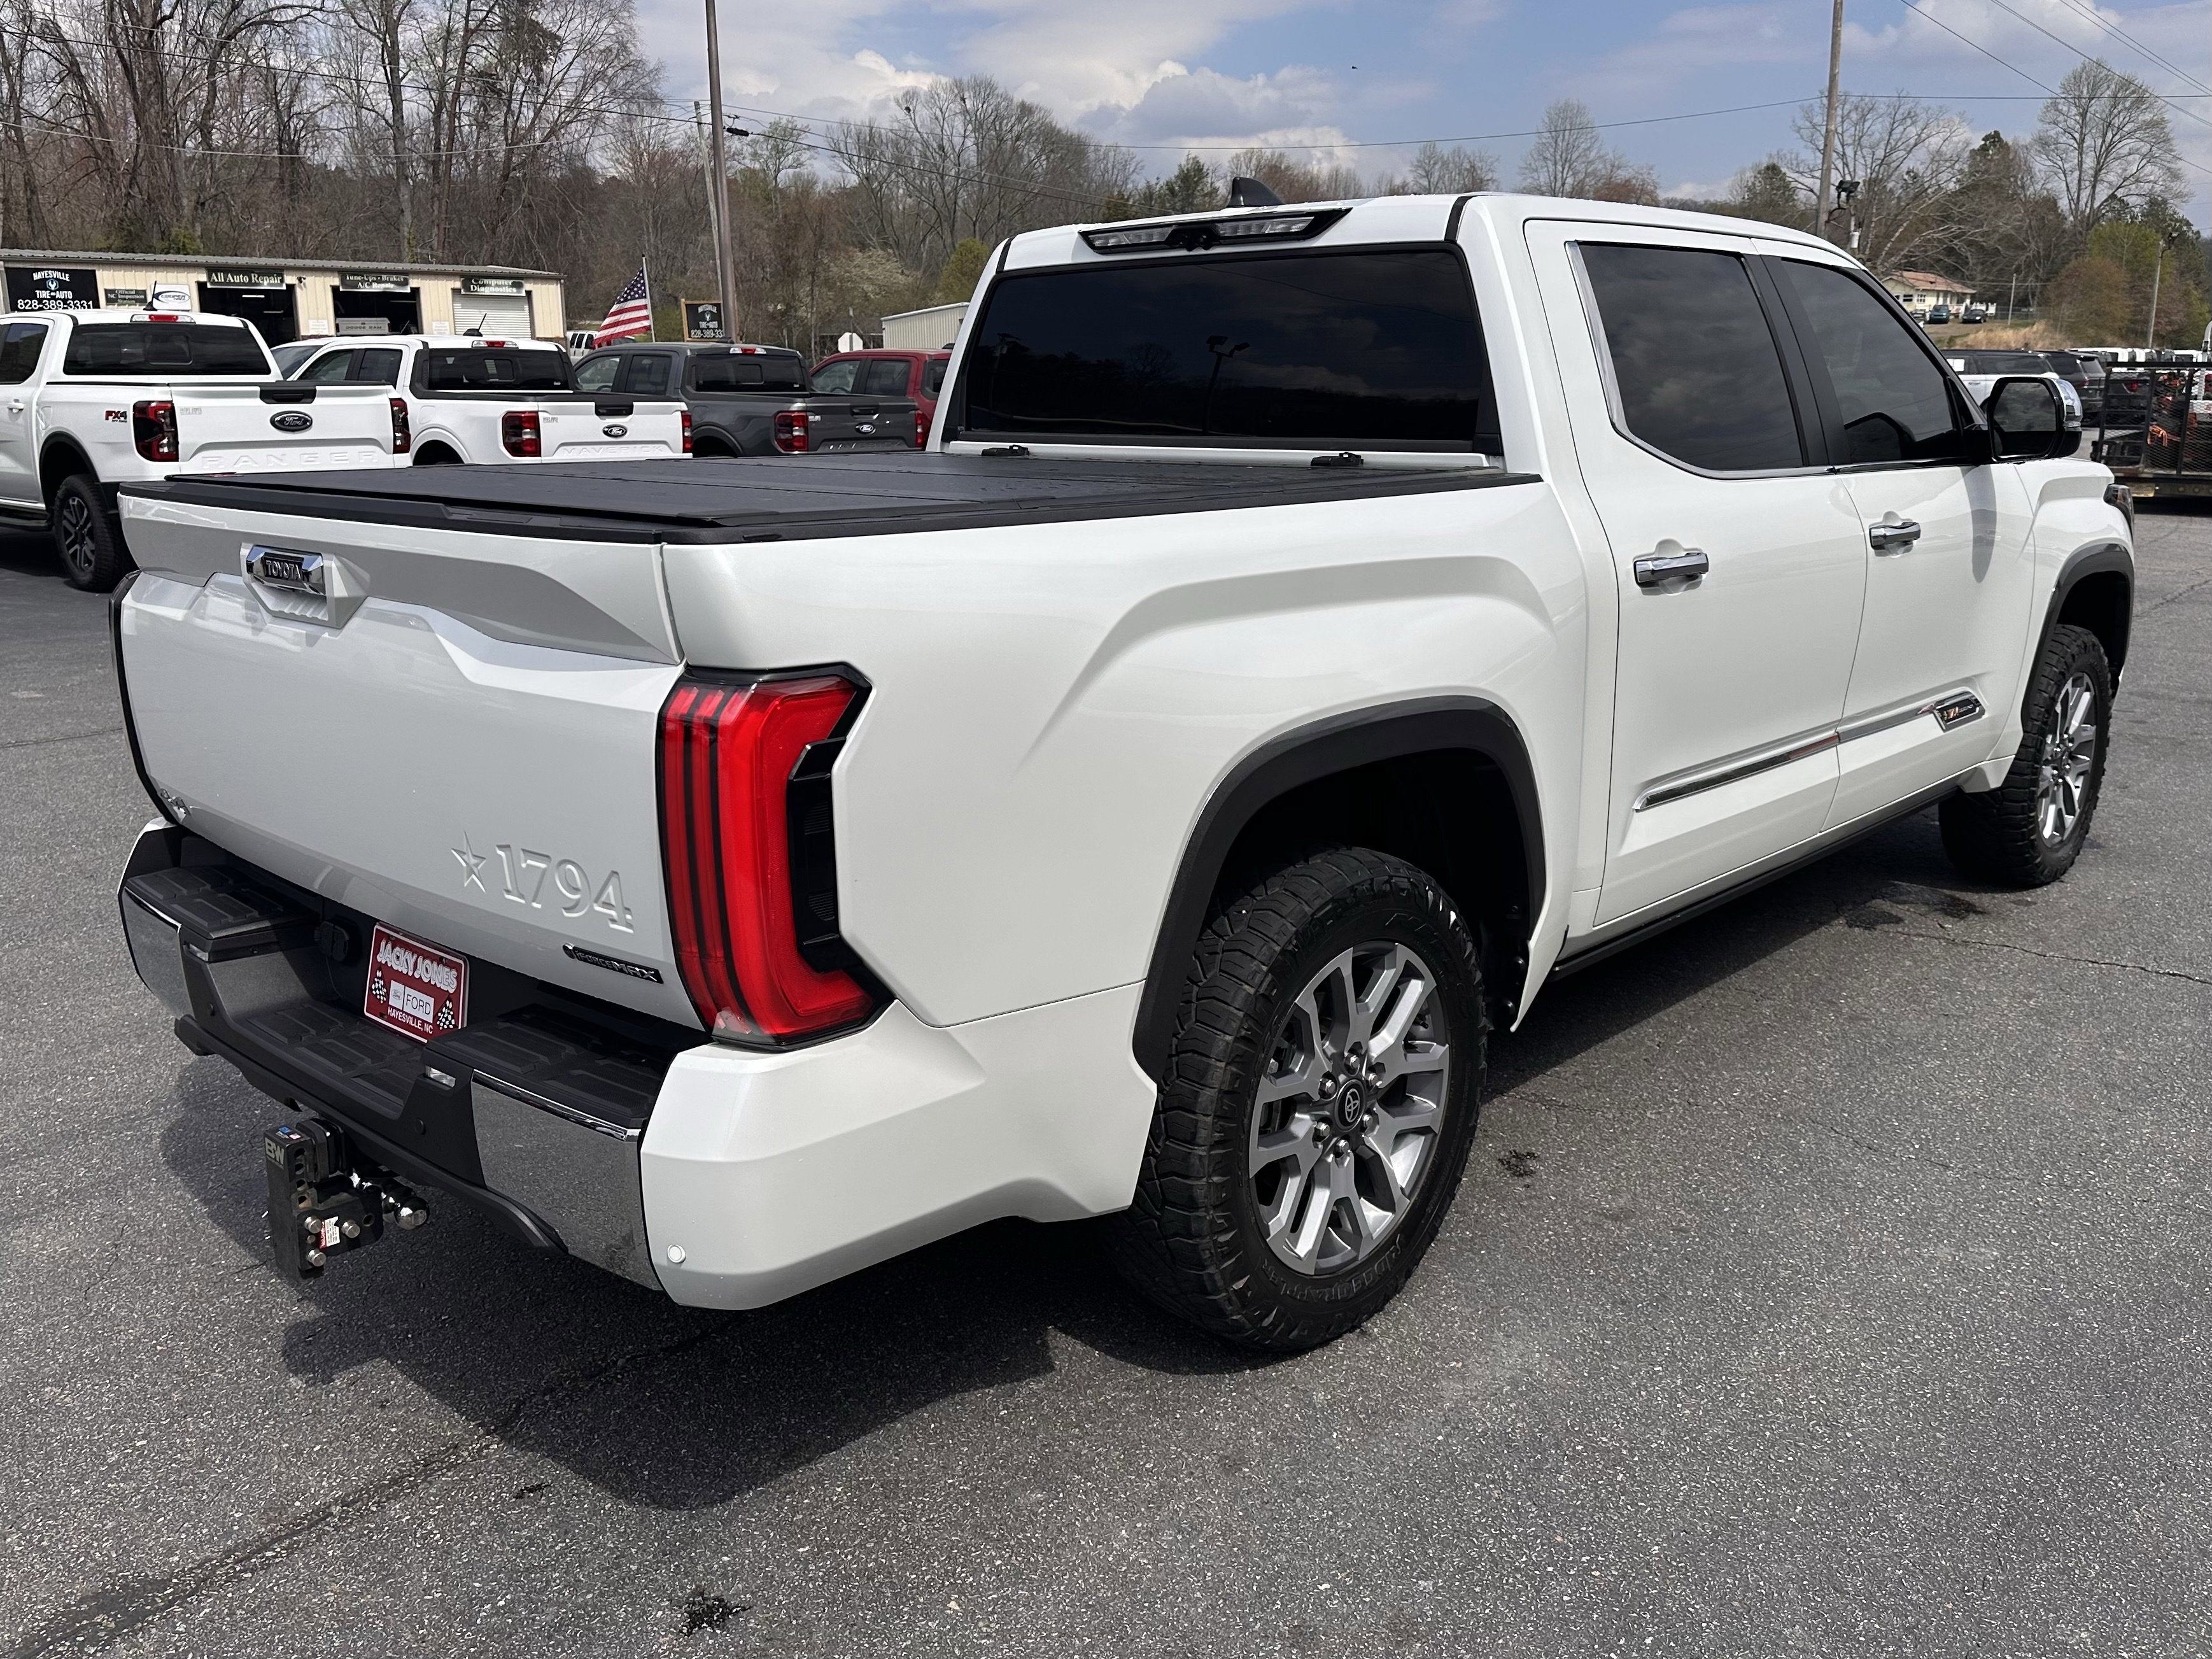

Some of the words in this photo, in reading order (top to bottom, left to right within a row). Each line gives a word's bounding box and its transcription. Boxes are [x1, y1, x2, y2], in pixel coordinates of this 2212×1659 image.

[32, 270, 71, 281] HAYESVILLE
[210, 272, 225, 283] All
[226, 272, 249, 283] Auto
[251, 273, 282, 286] Repair
[35, 290, 51, 299] TIRE
[56, 290, 73, 299] AUTO
[470, 285, 517, 293] Diagnostics
[17, 299, 94, 310] 828-389-3331
[105, 410, 127, 421] FX4
[563, 446, 663, 456] MAVERICK
[201, 451, 379, 469] RANGER
[265, 560, 301, 580] TOYOTA
[495, 844, 634, 934] 1794
[376, 938, 417, 977] JACKY
[414, 955, 458, 994] JONES
[405, 994, 432, 1015] FORD
[388, 1006, 423, 1031] HAYESVILLE,
[424, 1023, 433, 1034] NC
